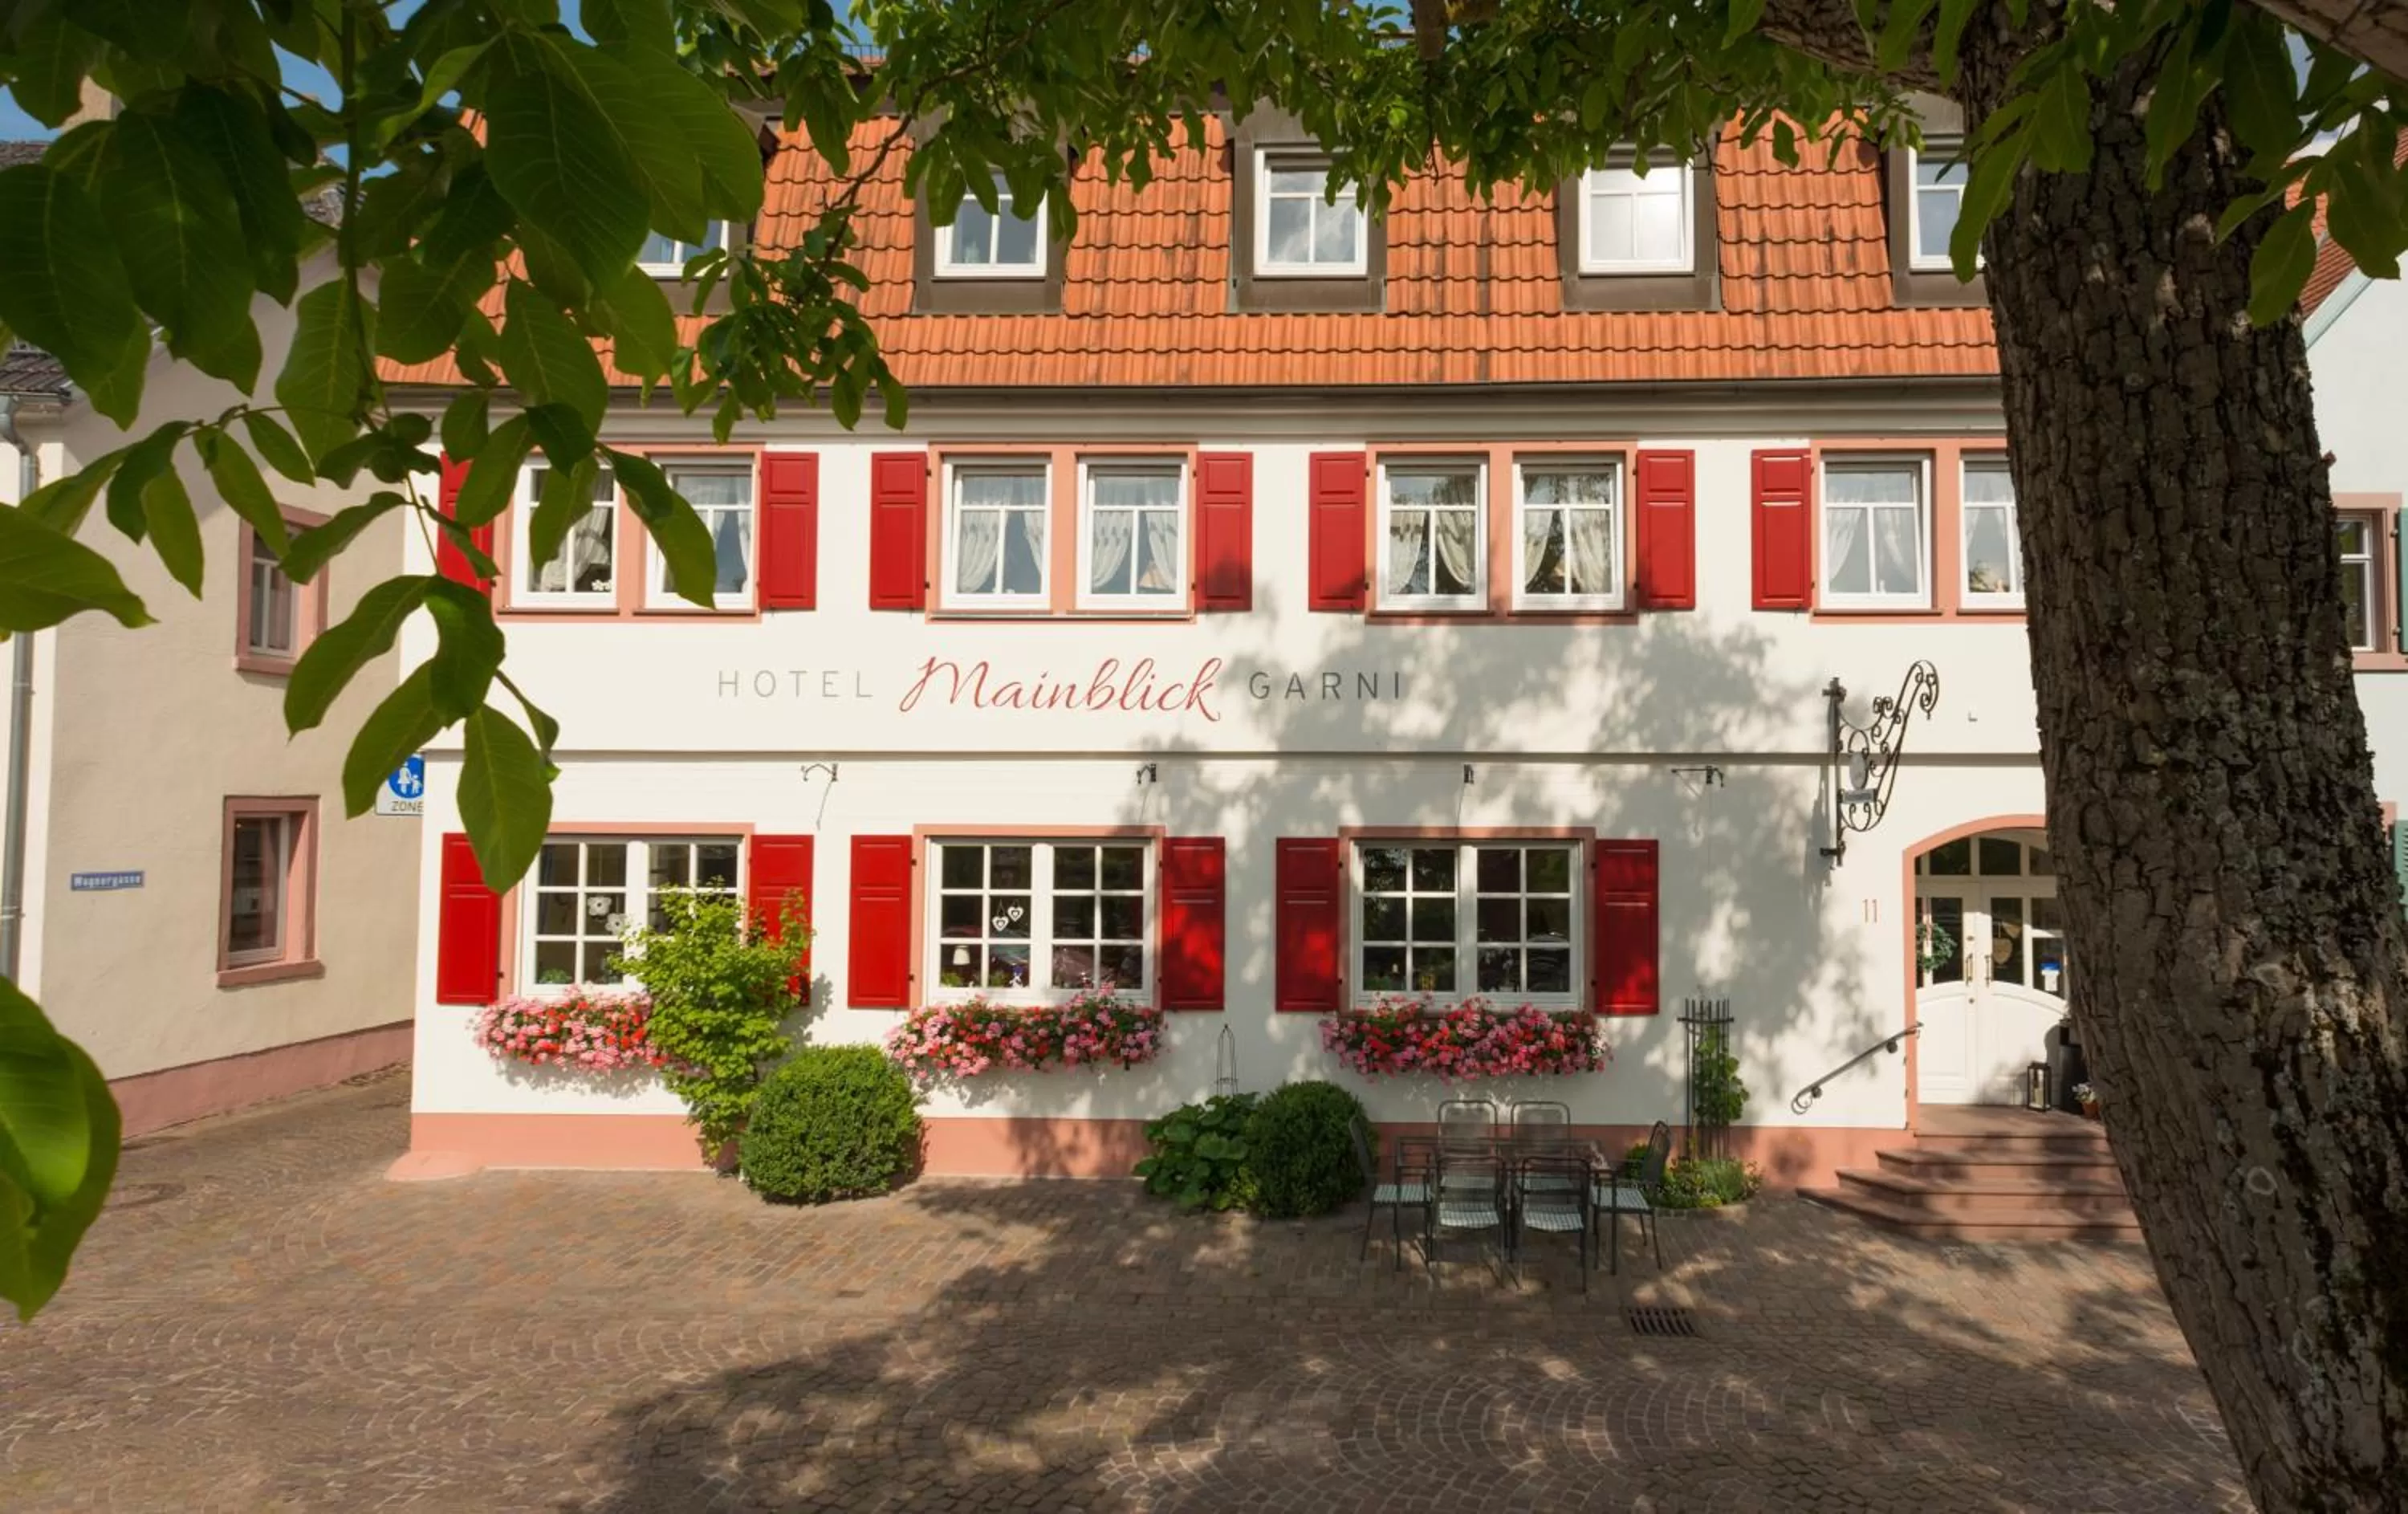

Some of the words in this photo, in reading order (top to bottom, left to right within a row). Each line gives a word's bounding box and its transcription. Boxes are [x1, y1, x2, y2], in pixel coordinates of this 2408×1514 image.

[718, 669, 873, 698] HOTEL
[899, 656, 1222, 722] Mainblick
[1249, 671, 1399, 700] GARNI
[391, 801, 424, 812] ZONE
[1862, 898, 1877, 923] 11
